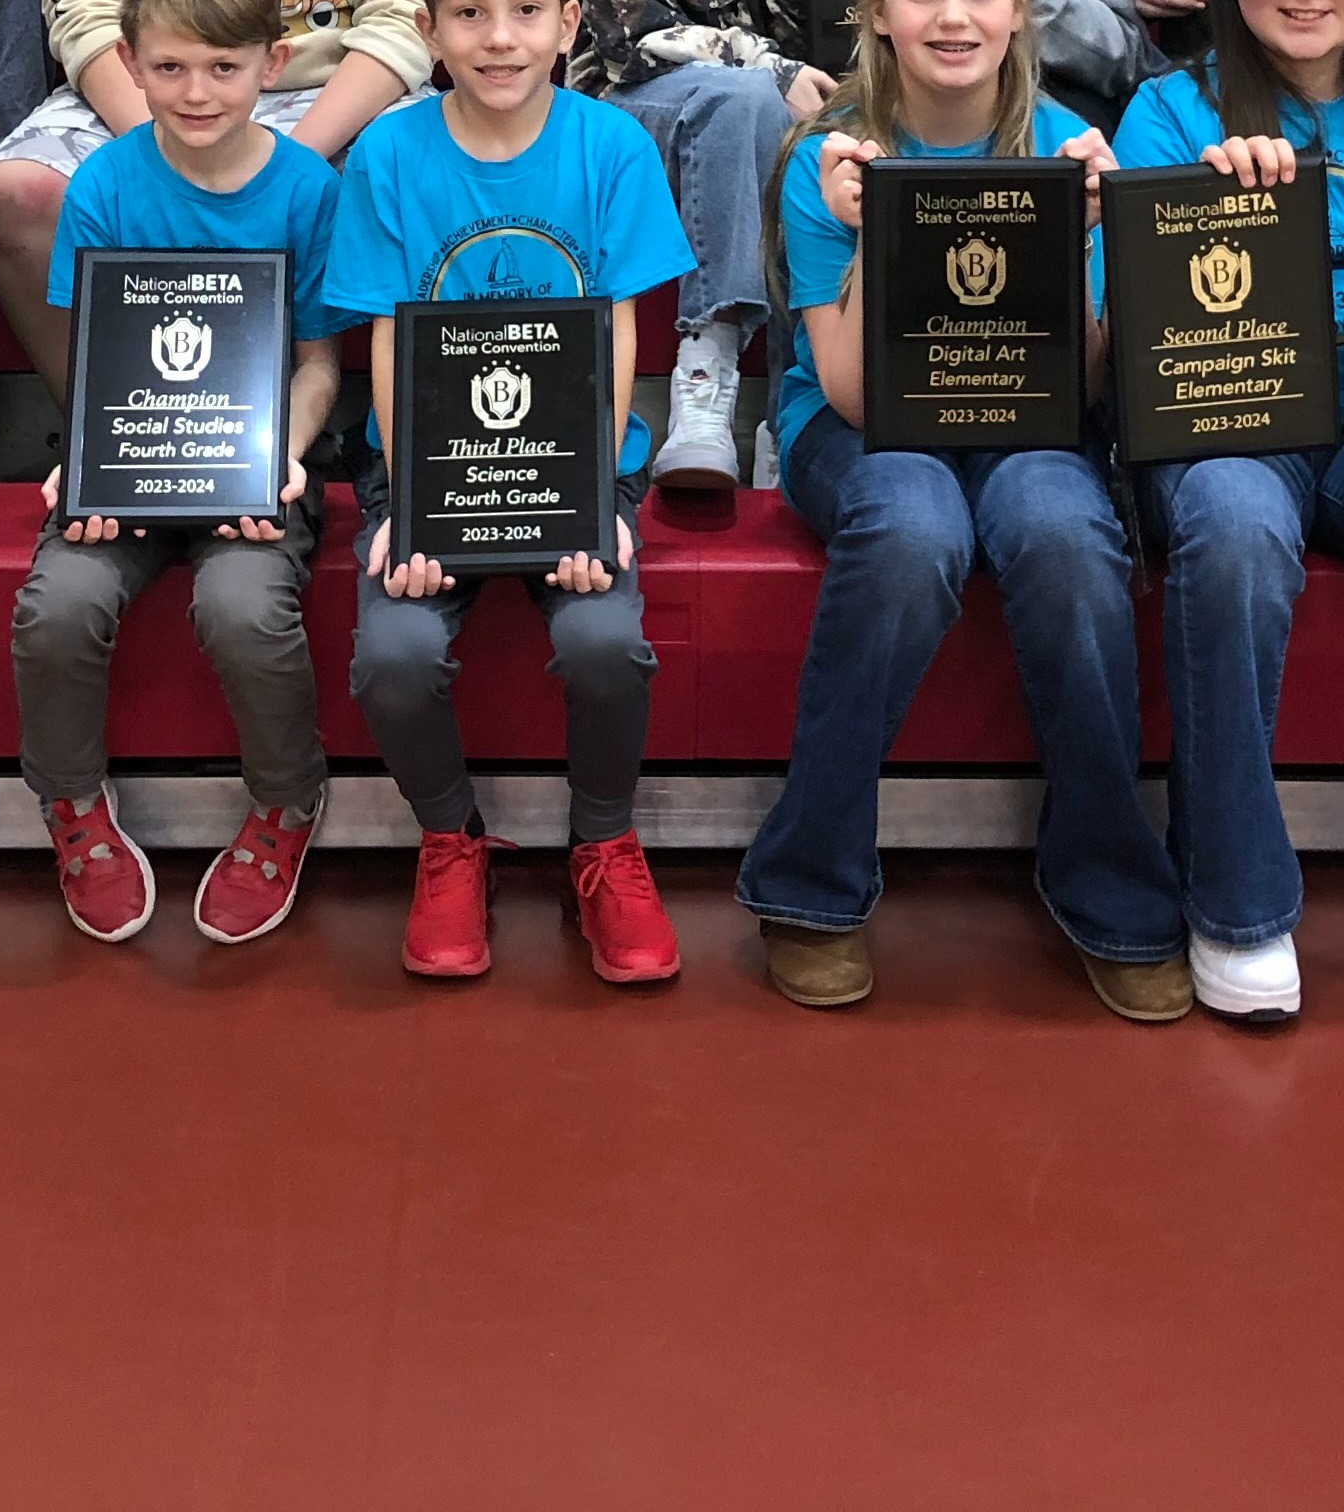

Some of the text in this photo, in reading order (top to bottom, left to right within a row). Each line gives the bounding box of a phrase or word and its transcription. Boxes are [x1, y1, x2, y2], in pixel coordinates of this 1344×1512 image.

[915, 191, 1034, 211] NationalBETA
[1155, 193, 1276, 220] NationalBETA
[915, 211, 1036, 224] State Convention
[1156, 213, 1279, 235] State Convention
[416, 251, 442, 301] ADERSHIP
[441, 214, 511, 251] ACHIEVEMENT
[517, 215, 577, 250] CHARACTER
[124, 273, 242, 292] NationalBETA
[538, 282, 552, 295] OF
[123, 292, 243, 304] State Convention
[441, 324, 558, 343] NationalBETA
[926, 316, 1027, 338] Champion
[1163, 319, 1287, 347] Second Place
[441, 341, 561, 356] State Convention
[928, 345, 1026, 365] Digital Art
[1158, 347, 1296, 380] Campaign Skit
[929, 371, 1025, 390] Elementary
[1175, 377, 1283, 400] Elementary
[128, 389, 230, 413] Champion
[938, 409, 1016, 423] 2023-2024
[1191, 412, 1271, 434] 2023-2024
[111, 417, 244, 435] Social Studies
[118, 440, 235, 458] Fourth Grade
[448, 437, 556, 457] Third Place
[465, 466, 538, 483] Science
[135, 479, 215, 494] 2023-2024
[444, 489, 560, 507] Fourth Grade
[462, 526, 541, 542] 2023-2024
